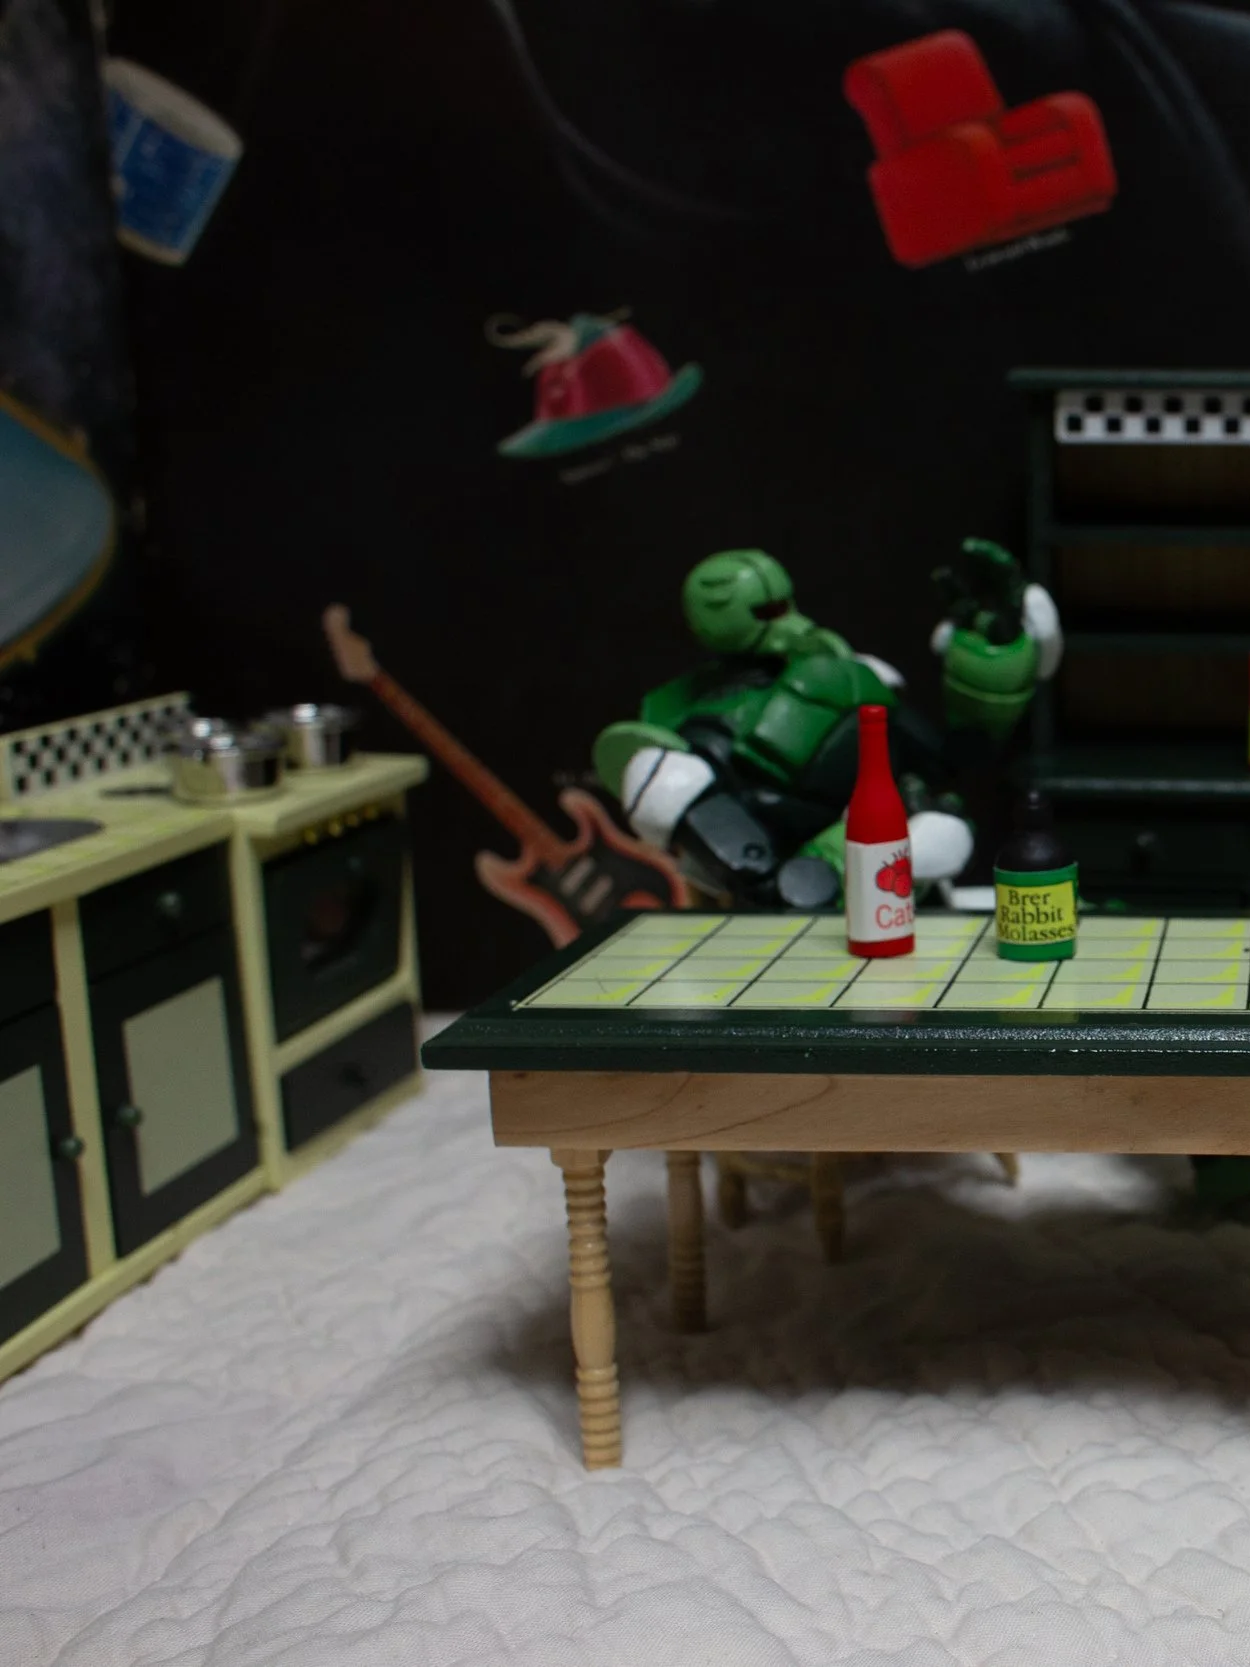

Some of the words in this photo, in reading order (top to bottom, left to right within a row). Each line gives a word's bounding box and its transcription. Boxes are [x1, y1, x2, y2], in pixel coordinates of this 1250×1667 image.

[1008, 889, 1051, 906] Brer
[1000, 905, 1064, 925] Rabbit
[999, 923, 1075, 942] Molasses
